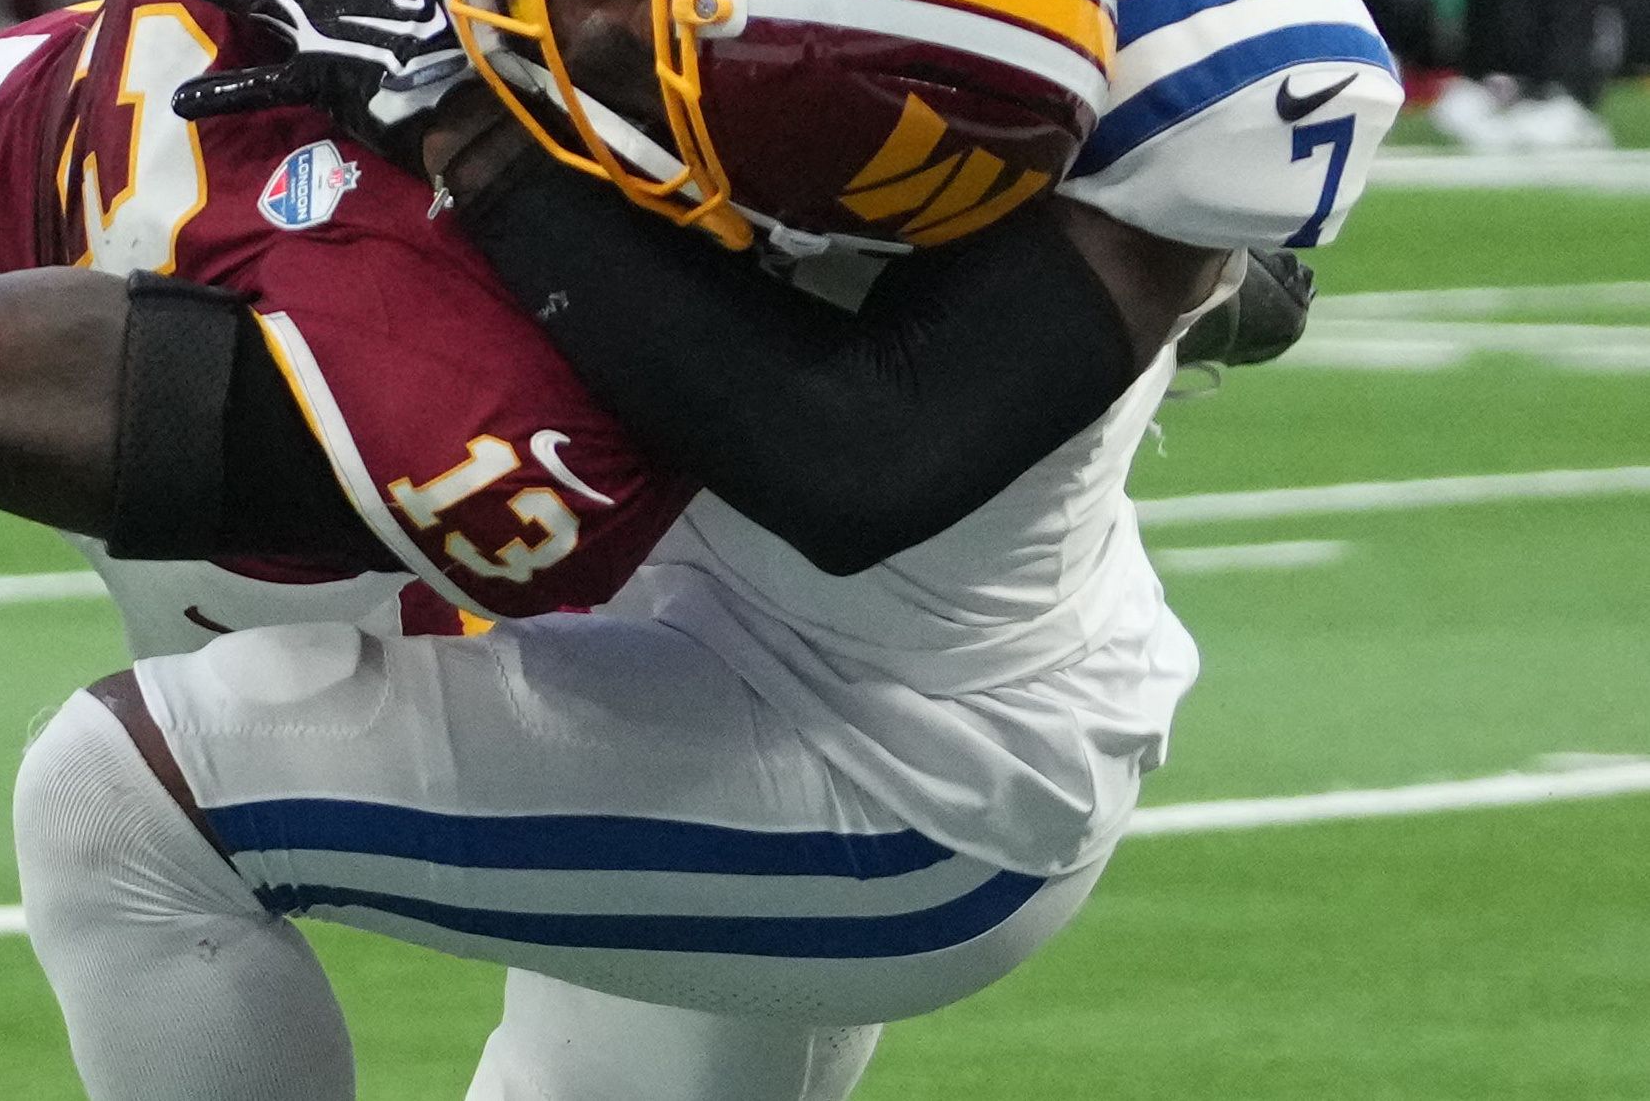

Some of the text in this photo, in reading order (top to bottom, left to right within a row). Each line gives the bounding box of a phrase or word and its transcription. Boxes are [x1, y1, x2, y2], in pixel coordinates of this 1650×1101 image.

[297, 153, 310, 220] LONDON
[1280, 113, 1356, 248] 7
[387, 434, 581, 584] 13
